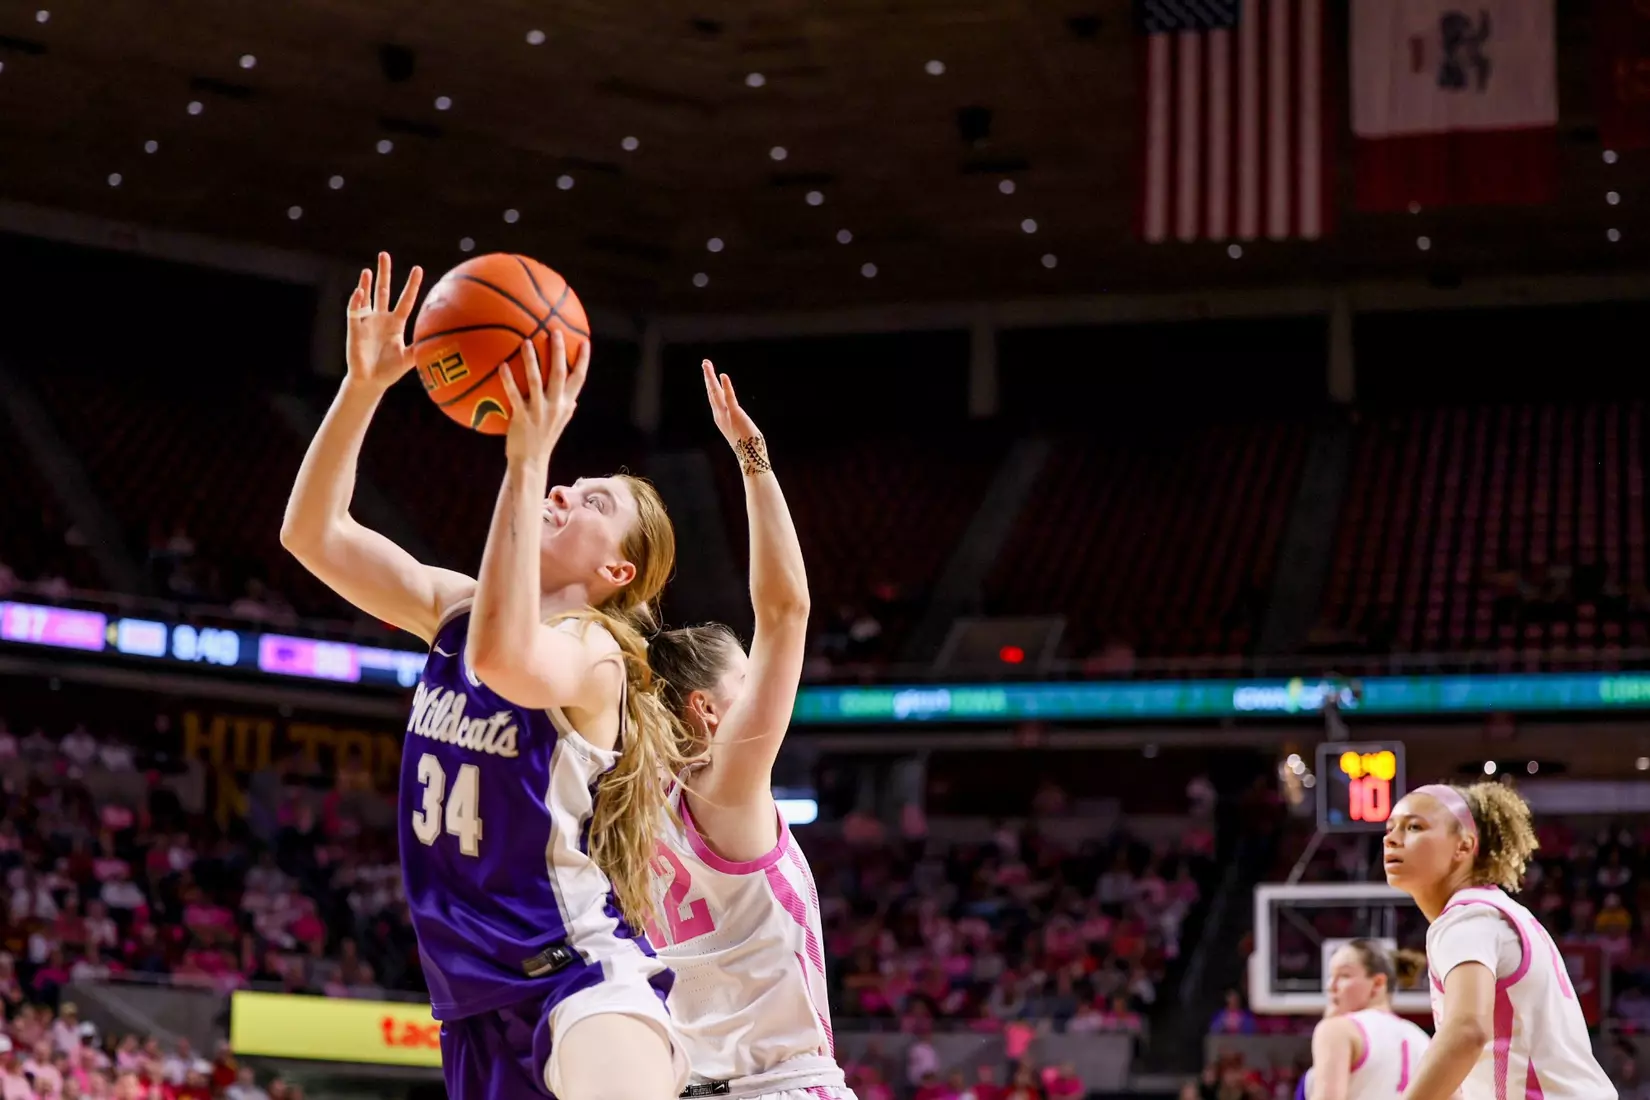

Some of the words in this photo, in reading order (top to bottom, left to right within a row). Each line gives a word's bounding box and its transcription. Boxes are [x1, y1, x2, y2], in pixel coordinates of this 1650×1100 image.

[407, 681, 519, 758] Wildcats
[412, 752, 483, 857] 34
[1349, 778, 1391, 822] 10
